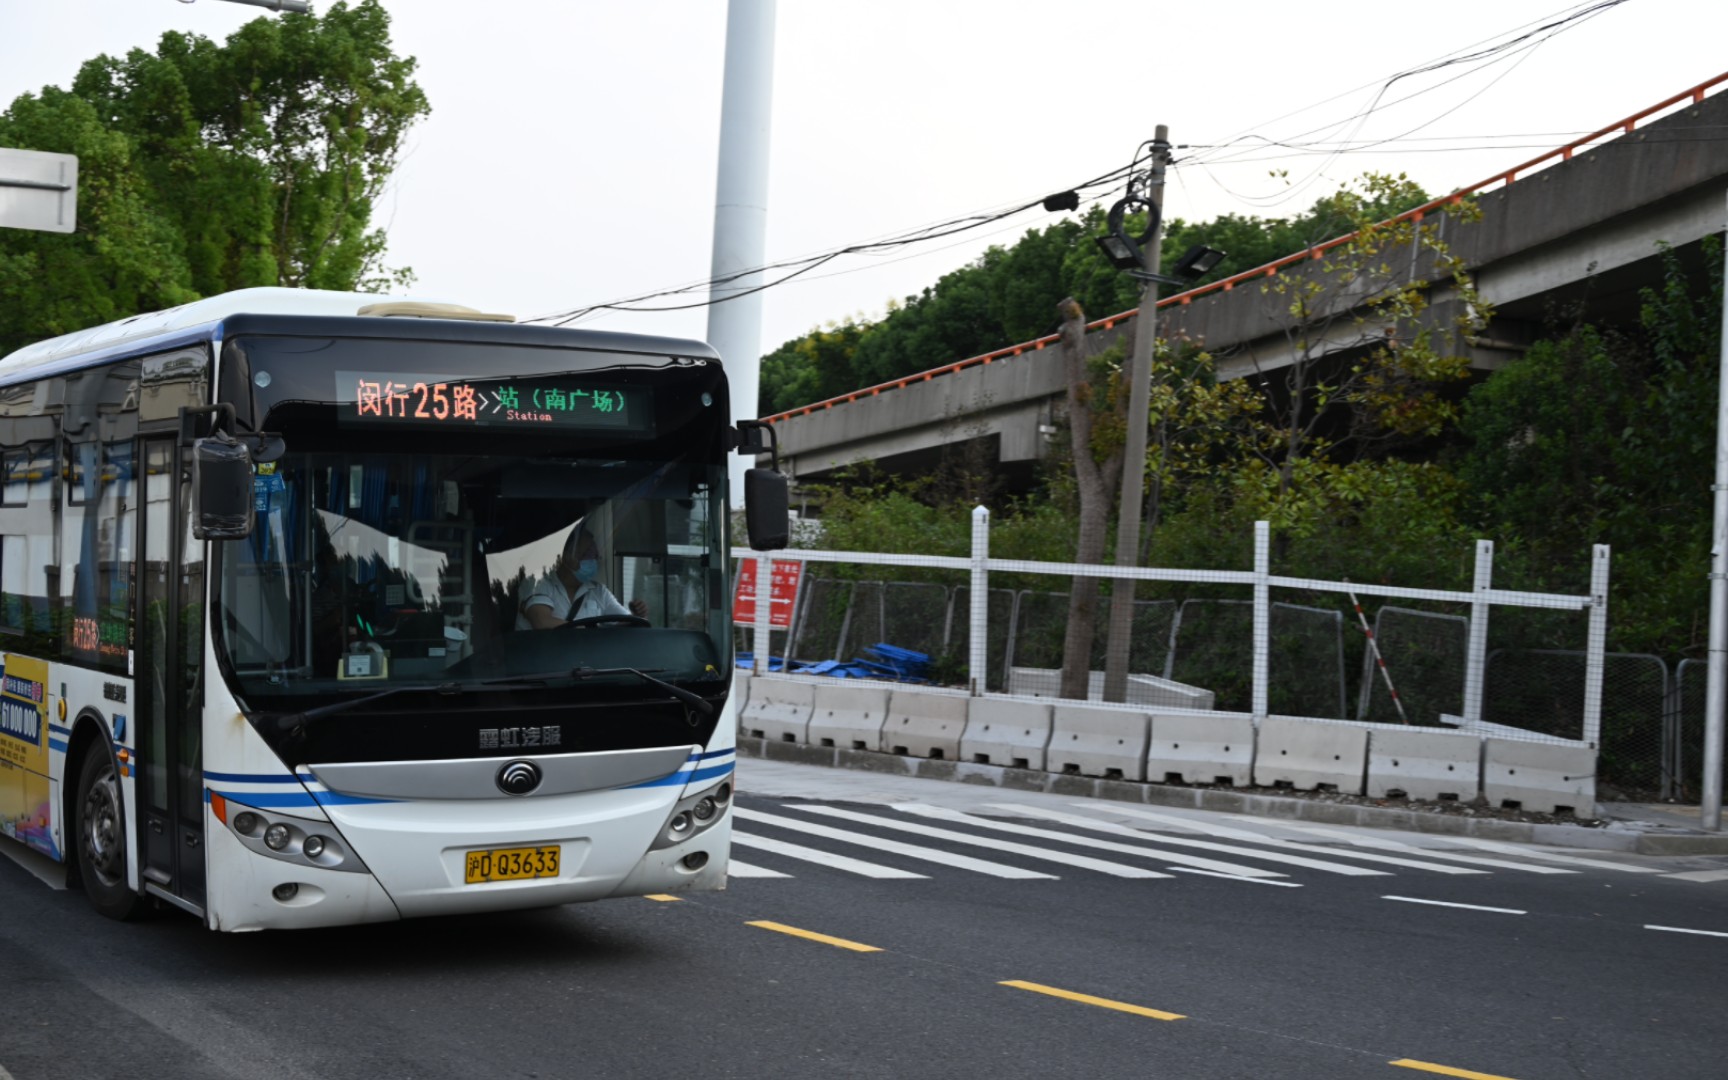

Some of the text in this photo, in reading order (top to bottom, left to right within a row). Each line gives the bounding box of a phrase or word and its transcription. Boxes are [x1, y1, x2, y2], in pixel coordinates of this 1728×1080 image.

[357, 378, 477, 420] 闵行25路
[507, 409, 552, 421] Station
